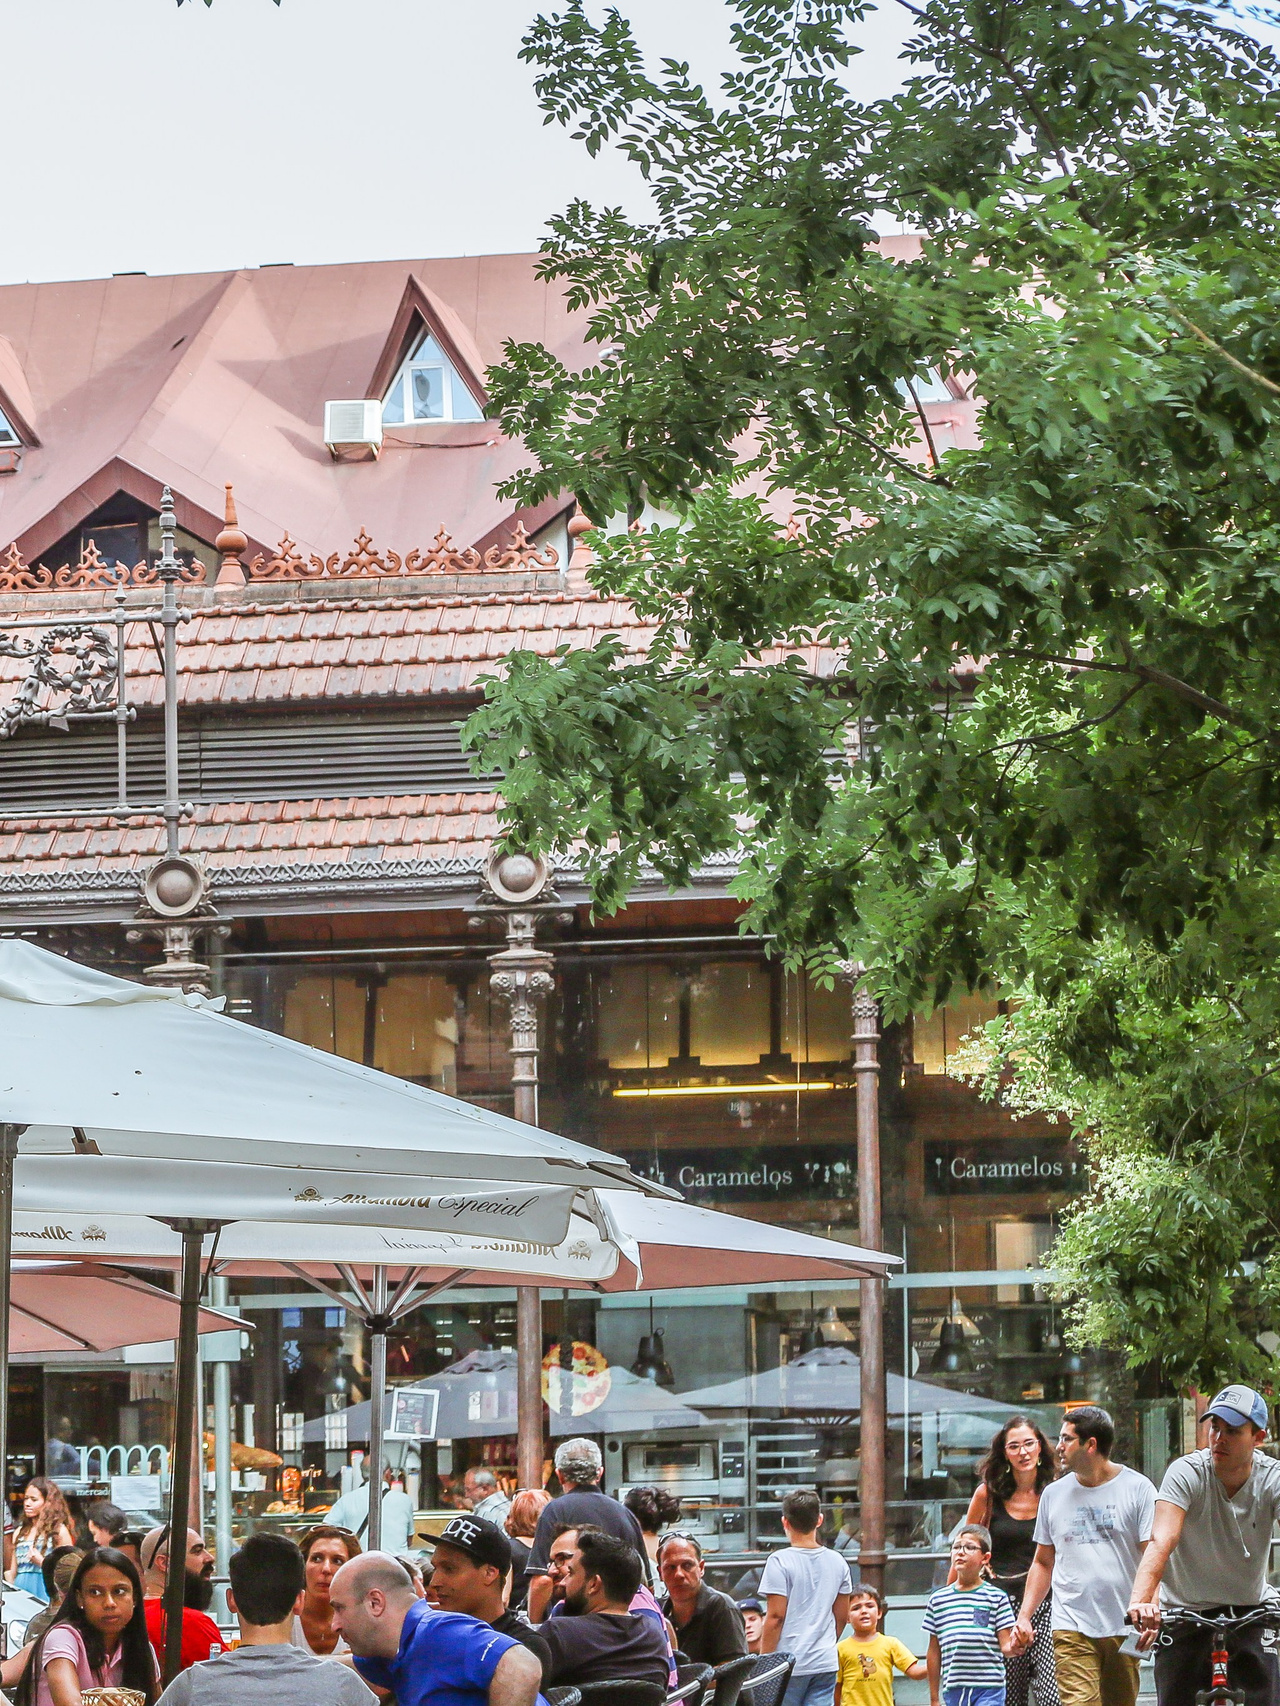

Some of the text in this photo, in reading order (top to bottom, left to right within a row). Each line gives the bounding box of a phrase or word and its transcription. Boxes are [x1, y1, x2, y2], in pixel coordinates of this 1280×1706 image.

[678, 1163, 793, 1188] Caramelos
[950, 1155, 1063, 1179] Caramelos
[437, 1195, 540, 1218] Especial
[76, 1486, 111, 1497] mercad
[442, 1518, 482, 1545] DOPE
